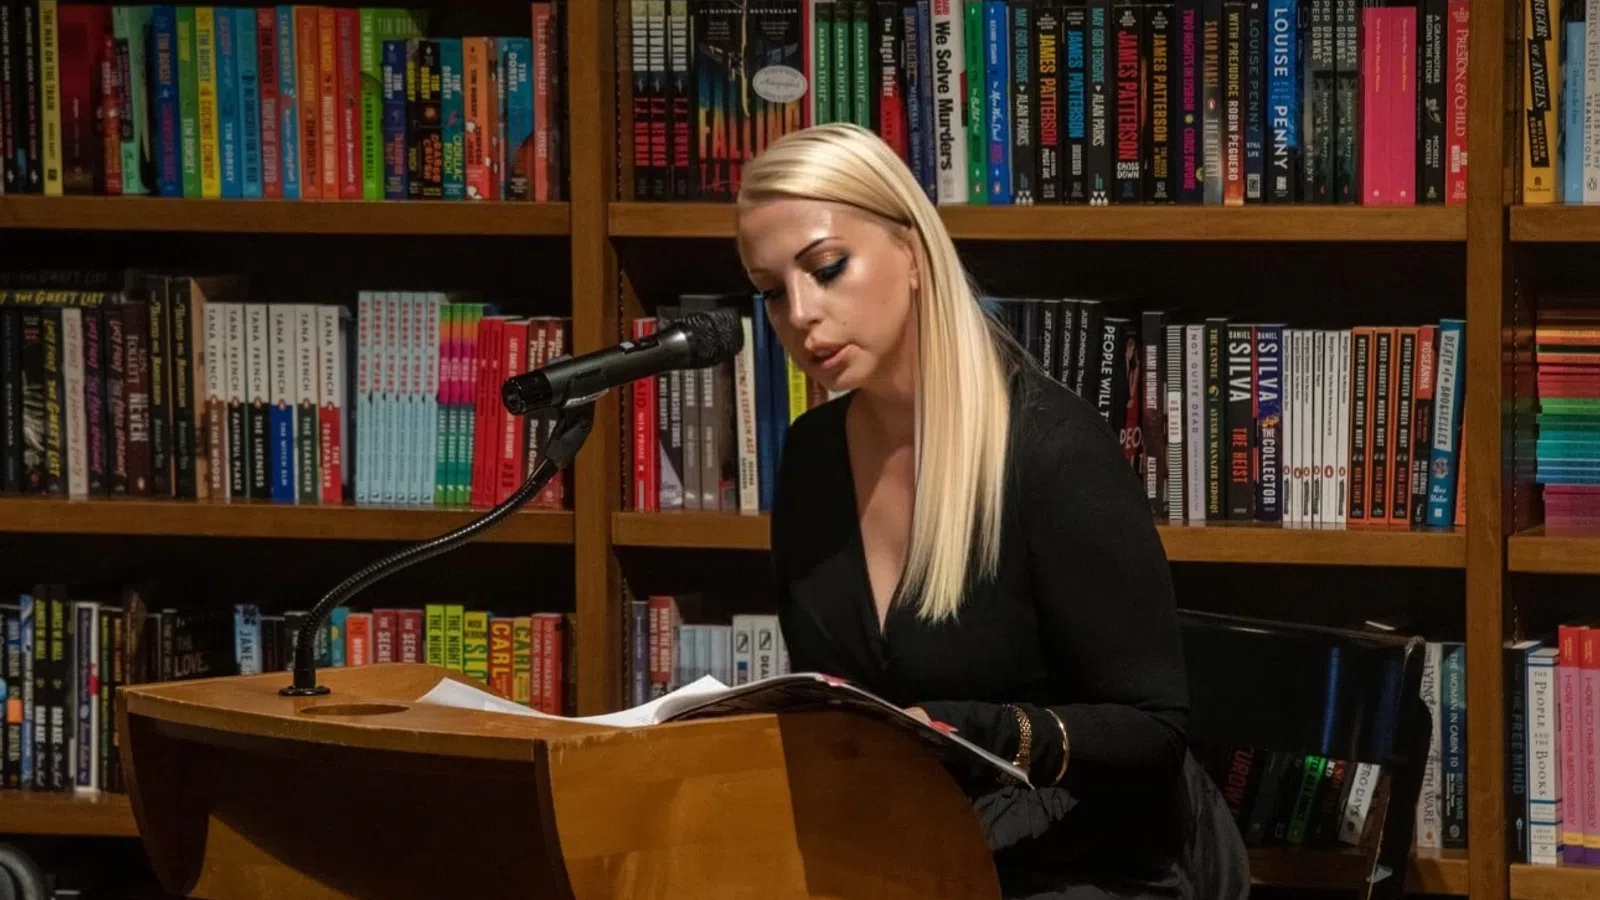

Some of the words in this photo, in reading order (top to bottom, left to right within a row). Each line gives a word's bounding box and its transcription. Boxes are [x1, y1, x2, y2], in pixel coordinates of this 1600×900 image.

[935, 21, 951, 45] We
[1015, 8, 1027, 27] MAY
[1091, 8, 1103, 27] MAY
[1228, 12, 1239, 39] WITH
[1425, 14, 1433, 41] BEGINS
[1534, 0, 1548, 38] RIGOR
[879, 35, 896, 64] Angel
[1016, 29, 1028, 47] GOD
[1039, 33, 1056, 74] JAMES
[1067, 30, 1084, 69] JAMES
[1092, 29, 1104, 47] GOD
[1153, 33, 1167, 73] JAMES
[1249, 19, 1259, 74] LOUISE
[1273, 8, 1288, 78] LOUISE
[1311, 26, 1322, 61] GOWNS
[1425, 43, 1433, 58] THE
[1433, 23, 1441, 83] GRANDMOTHER
[1016, 48, 1028, 84] FORGIVE
[1092, 48, 1104, 84] FORGIVE
[1117, 31, 1138, 78] JAMES
[1228, 42, 1239, 98] PREJUDICE
[1455, 29, 1469, 82] PRESTON
[384, 66, 394, 99] DORSEY
[393, 73, 402, 91] TIM
[431, 75, 440, 92] TIM
[442, 65, 452, 100] DORSEY
[452, 74, 461, 92] TIM
[508, 52, 517, 93] DORSEY
[518, 62, 526, 83] TIM
[883, 66, 896, 98] Maker
[936, 50, 952, 95] Solve
[1425, 60, 1433, 84] STORY
[1532, 58, 1546, 109] ANGELS
[1016, 93, 1029, 117] ALAN
[1039, 77, 1057, 146] PATTERSON
[1068, 72, 1084, 139] PATTERSON
[1092, 93, 1105, 117] ALAN
[1117, 81, 1138, 161] PATTERSON
[1153, 75, 1167, 143] PATTERSON
[1228, 100, 1239, 132] ROBIN
[1250, 80, 1259, 134] PENNY
[1455, 95, 1467, 137] CHILD
[938, 98, 955, 171] Murders
[1016, 119, 1029, 147] PARKS
[1092, 119, 1105, 147] PARKS
[1273, 104, 1288, 170] PENNY
[1536, 119, 1546, 158] WILLIAM
[422, 139, 433, 180] CRUSH
[453, 134, 462, 181] CADILLAC
[1117, 161, 1140, 170] CROSS
[1228, 134, 1239, 182] PEGUERO
[1116, 171, 1140, 180] DOWN
[208, 308, 216, 339] TANA
[229, 310, 237, 341] TANA
[251, 310, 260, 342] TANA
[276, 313, 284, 344] TANA
[301, 313, 310, 342] TANA
[325, 315, 333, 346] TANA
[1044, 310, 1052, 329] JUST
[1064, 309, 1072, 329] JUST
[1080, 309, 1088, 329] JUST
[1100, 325, 1115, 374] PEOPLE
[1190, 333, 1198, 356] NOT
[1209, 328, 1218, 346] THE
[1440, 335, 1455, 366] DEATH
[127, 334, 140, 384] FOLLETT
[209, 345, 218, 390] FRENCH
[230, 346, 239, 392] FRENCH
[252, 347, 261, 392] FRENCH
[277, 349, 285, 395] FRENCH
[302, 348, 310, 392] FRENCH
[326, 351, 334, 396] FRENCH
[1146, 345, 1157, 370] MIAMI
[1210, 347, 1218, 380] CENTRE
[1228, 342, 1252, 402] SILVA
[1257, 343, 1278, 402] SILVA
[1356, 337, 1366, 398] MOTHER-DAUGHTER
[1377, 336, 1388, 397] MOTHER-DAUGHTER
[1401, 337, 1412, 398] MOTHER-DAUGHTER
[1420, 340, 1432, 389] ROSEANNA
[1076, 370, 1085, 382] The
[1098, 377, 1112, 407] WILL
[1146, 371, 1157, 411] MIDNIGHT
[1190, 362, 1199, 398] QUITE
[211, 410, 220, 422] IN
[254, 415, 263, 434] THE
[303, 416, 311, 436] THE
[1191, 403, 1199, 434] DEAD
[1355, 400, 1365, 425] MURDER
[1376, 399, 1386, 424] MURDER
[1400, 400, 1409, 425] MURDER
[1435, 386, 1452, 446] BOOKSELLER
[212, 426, 220, 445] THE
[1232, 428, 1247, 447] THE
[1262, 428, 1275, 437] THE
[1355, 428, 1364, 448] NIGHT
[1376, 428, 1385, 448] NIGHT
[1399, 428, 1408, 448] NIGHT
[212, 448, 221, 489] WOODS
[255, 438, 263, 488] LIKENESS
[303, 439, 312, 493] SEARCHER
[322, 423, 331, 488] TRESPASSER
[332, 446, 340, 465] THE
[1147, 456, 1156, 473] ALEX
[1232, 452, 1247, 484] HEIST
[1262, 438, 1276, 505] COLLECTOR
[233, 460, 241, 491] PLACE
[429, 615, 441, 630] THE
[448, 615, 460, 631] THE
[239, 630, 253, 662] JANE
[378, 632, 392, 663] SECRE
[403, 633, 416, 663] SECRE
[447, 636, 460, 665] NIGHT
[491, 624, 510, 678] CARL
[514, 626, 530, 678] CARL
[1449, 652, 1458, 671] THE
[1449, 672, 1458, 710] WOMAN
[1535, 681, 1547, 728] PEOPLE
[1449, 712, 1458, 722] IN
[1511, 713, 1524, 750] FREE
[1449, 725, 1459, 753] CABIN
[1449, 756, 1458, 767] 10
[1512, 753, 1525, 795] MIND
[1535, 750, 1549, 796] BOOKS
[1350, 788, 1366, 817] DAYS
[1423, 789, 1434, 825] WARE
